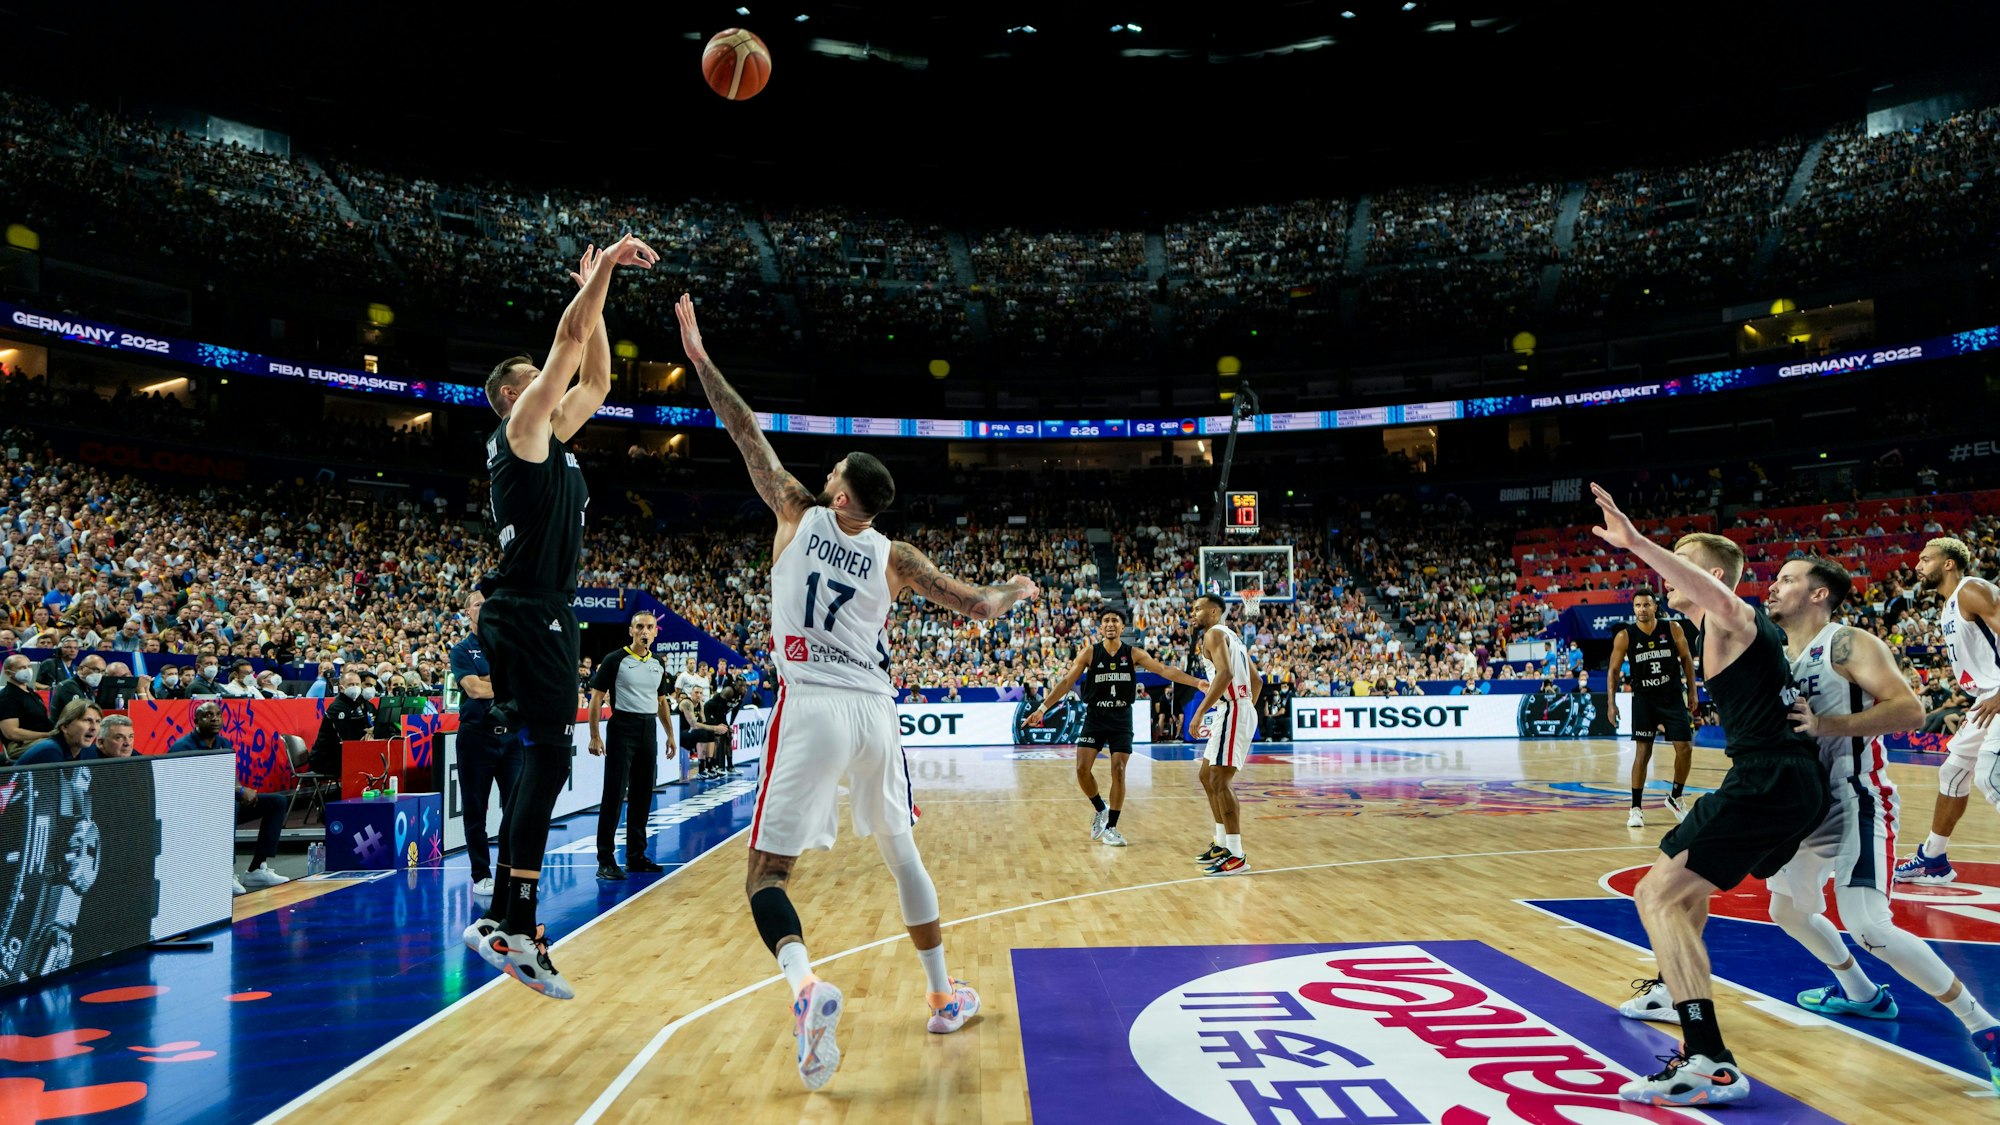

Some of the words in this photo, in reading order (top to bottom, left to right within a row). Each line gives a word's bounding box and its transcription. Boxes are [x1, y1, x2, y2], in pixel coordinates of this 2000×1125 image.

[12, 310, 116, 343] GERMANY
[120, 333, 170, 354] 2022
[1778, 355, 1867, 378] GERMANY
[1872, 344, 1923, 364] 2022
[269, 362, 305, 378] FIBA
[308, 367, 408, 392] EUROBASKET
[1531, 395, 1563, 409] FIBA
[1565, 383, 1661, 404] EUROBASKET
[598, 404, 634, 418] 2022
[1016, 425, 1034, 434] 53
[1070, 426, 1100, 436] 5:26
[1136, 423, 1155, 433] 62
[79, 440, 246, 480] COLOGNE
[1232, 494, 1256, 507] 5:25
[1500, 487, 1530, 502] BRING
[1532, 485, 1551, 500] THE
[1237, 507, 1255, 524] 10
[806, 533, 872, 580] POIRIER
[568, 596, 627, 608] ASKET
[804, 571, 857, 633] 17
[656, 642, 680, 652] BRING
[682, 640, 699, 650] THE
[1635, 648, 1672, 663] DEUTSCHLAND
[1649, 661, 1662, 674] 32
[1095, 672, 1132, 683] DEUTSCHLAND
[1641, 678, 1661, 687] ING
[1110, 684, 1116, 697] 4
[1096, 700, 1114, 708] ING
[1344, 705, 1470, 729] TISSOT
[564, 724, 575, 736] IN
[738, 720, 764, 751] TISSOT
